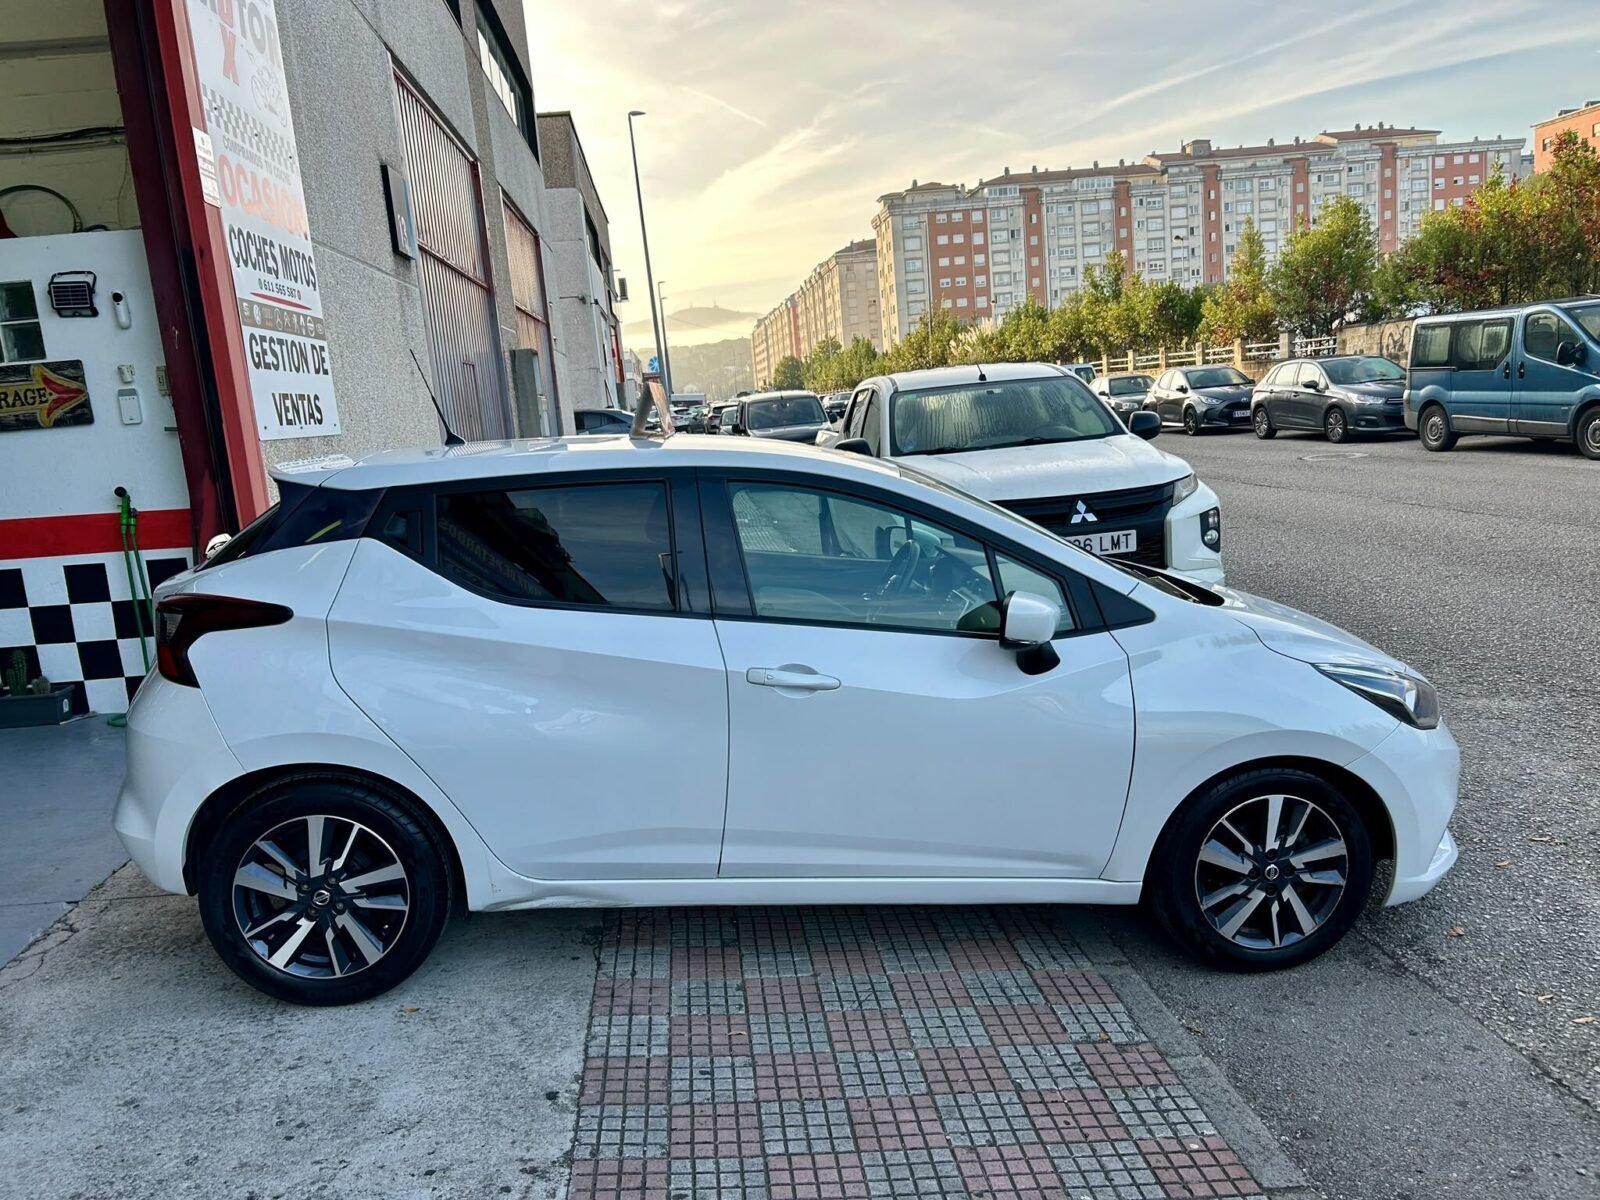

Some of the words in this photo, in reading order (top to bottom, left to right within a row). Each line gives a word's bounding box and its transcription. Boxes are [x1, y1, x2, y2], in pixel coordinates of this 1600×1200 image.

[229, 224, 280, 278] COCHES
[279, 245, 316, 290] MOTOS
[263, 278, 274, 293] 611
[275, 281, 286, 296] 565
[287, 284, 297, 298] 587
[249, 333, 309, 374] GESTION
[311, 343, 329, 376] DE
[272, 393, 324, 426] VENTAS
[1099, 533, 1132, 553] LMT
